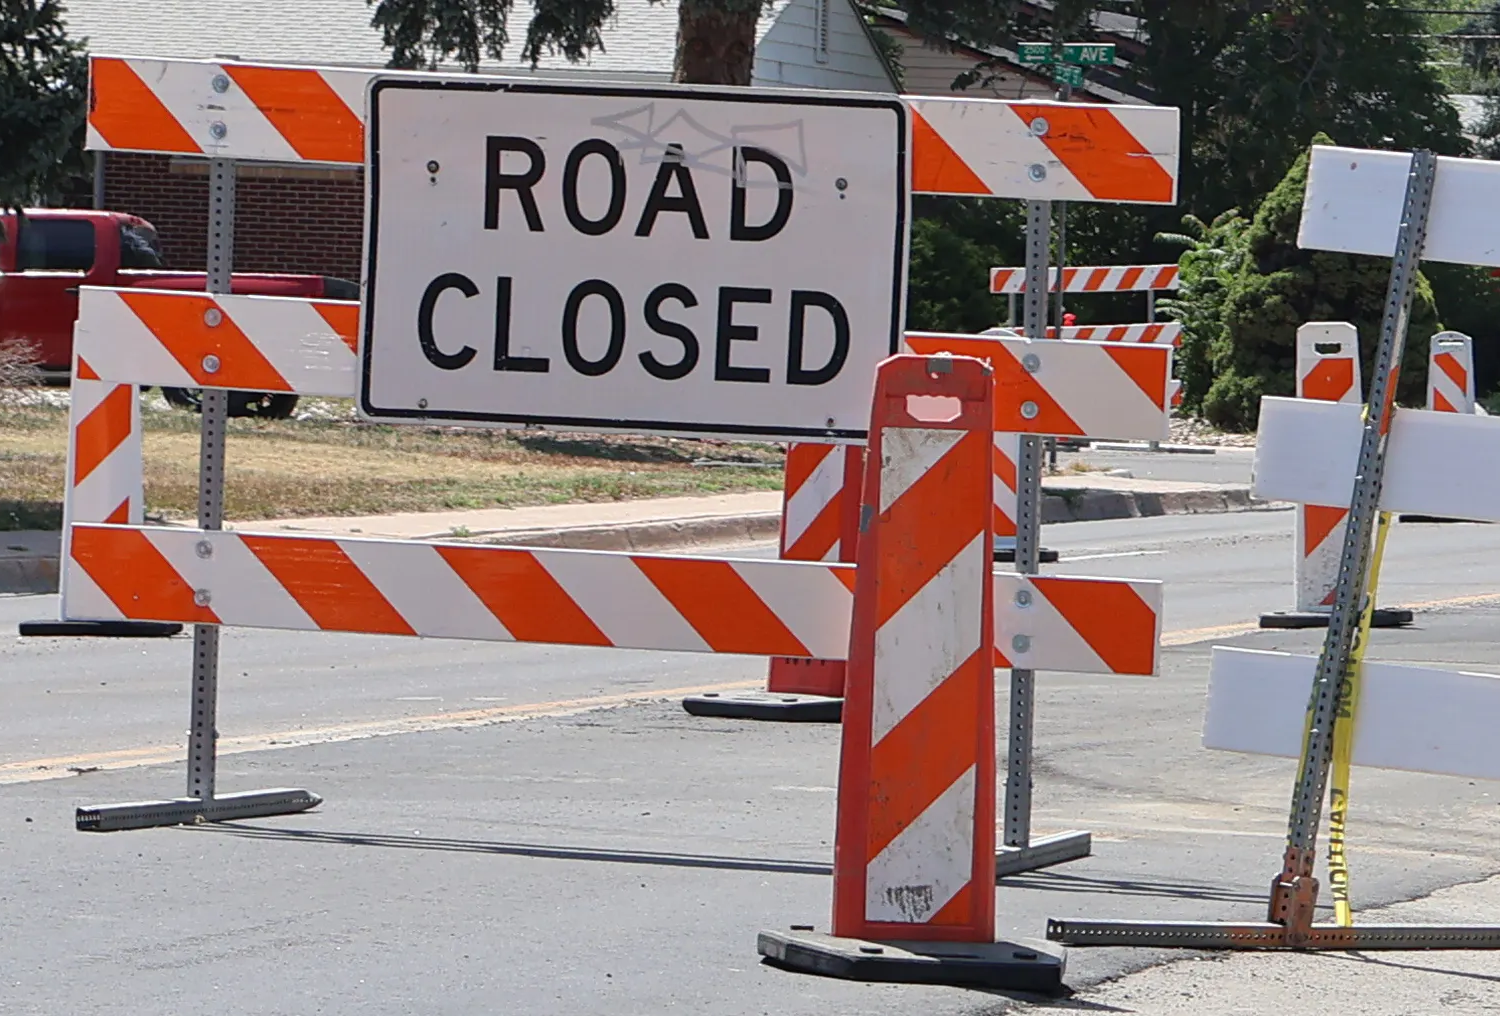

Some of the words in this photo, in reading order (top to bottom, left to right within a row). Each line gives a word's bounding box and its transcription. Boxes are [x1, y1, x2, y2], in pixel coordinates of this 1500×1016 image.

[1079, 46, 1109, 61] AVE
[483, 134, 795, 243] ROAD
[416, 272, 850, 388] CLOSED
